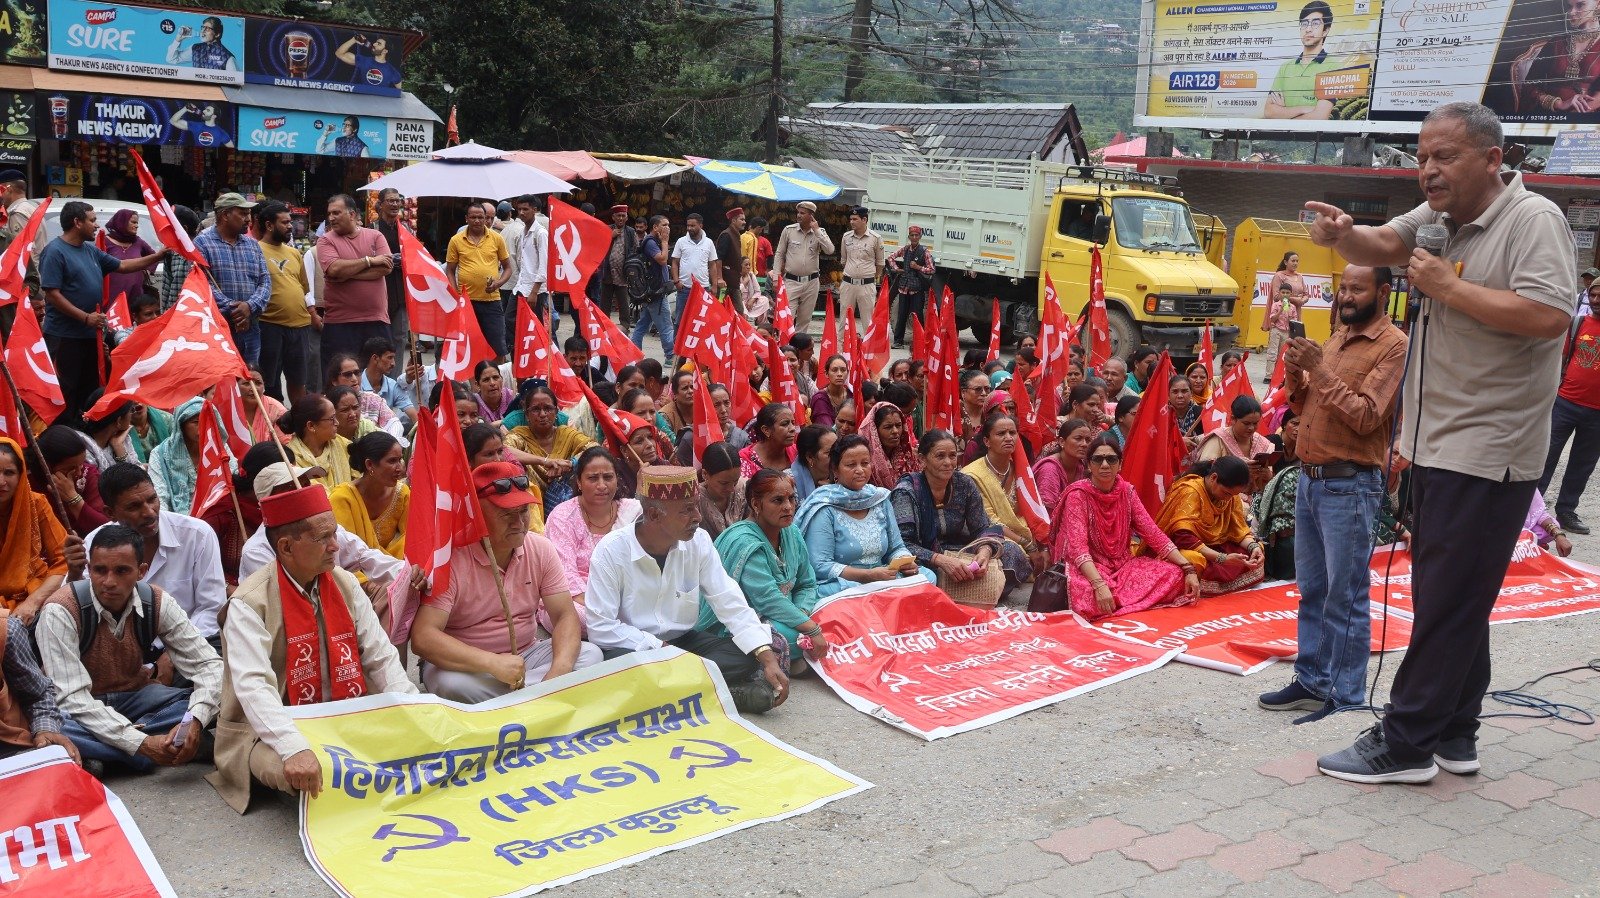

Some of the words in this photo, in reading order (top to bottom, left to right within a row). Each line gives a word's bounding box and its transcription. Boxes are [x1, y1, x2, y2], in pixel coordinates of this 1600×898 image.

[87, 9, 117, 21] CAMPA
[1166, 6, 1193, 15] ALLEN
[1441, 13, 1469, 23] SALE
[66, 23, 136, 51] SURE
[1441, 36, 1462, 46] Aug.
[55, 57, 81, 68] THAKUR
[81, 60, 100, 70] NEWS
[100, 62, 125, 72] AGENCY
[125, 64, 130, 73] &
[130, 65, 179, 77] CONFECTIONERY
[274, 77, 298, 87] RANA
[298, 80, 322, 90] NEWS
[322, 83, 355, 92] AGENCY
[1171, 74, 1194, 88] AIR
[1194, 73, 1217, 88] 128
[1320, 73, 1361, 85] HIMACHAL
[1323, 84, 1355, 96] TOPPER
[94, 102, 146, 120] THAKUR
[77, 120, 113, 137] NEWS
[114, 121, 162, 139] AGENCY
[395, 122, 425, 132] RANA
[250, 128, 299, 149] SURE
[395, 132, 425, 143] NEWS
[389, 143, 431, 153] AGENCY
[946, 231, 966, 240] KULLU
[1169, 614, 1253, 640] DISTRICT
[320, 743, 496, 799] हिमाचल
[493, 723, 632, 775] किसान
[623, 692, 711, 739] सभा
[480, 760, 661, 823] (HKS)
[493, 824, 619, 867] जिला
[608, 793, 741, 835] कुल्लू
